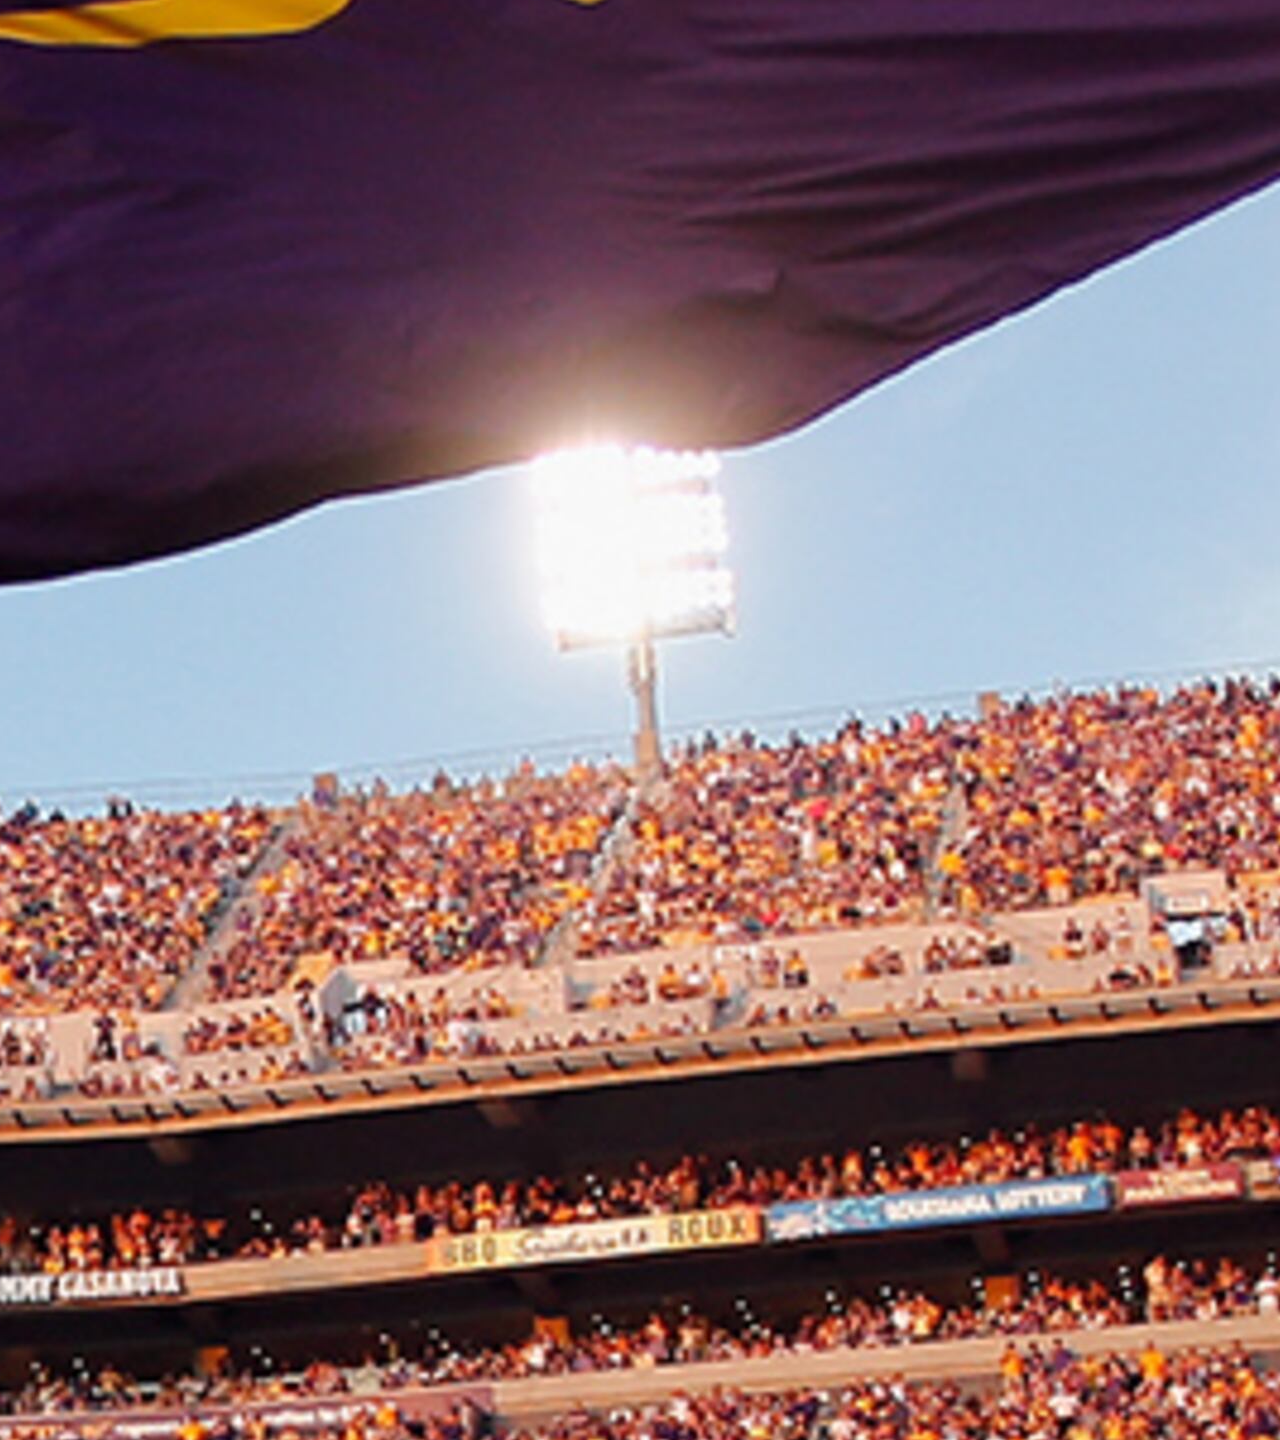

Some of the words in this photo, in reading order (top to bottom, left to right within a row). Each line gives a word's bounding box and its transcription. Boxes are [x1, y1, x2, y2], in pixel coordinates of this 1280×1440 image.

[994, 1182, 1088, 1211] LOTTERY
[667, 1213, 747, 1246] ROUX
[57, 1266, 182, 1299] CASANOVA
